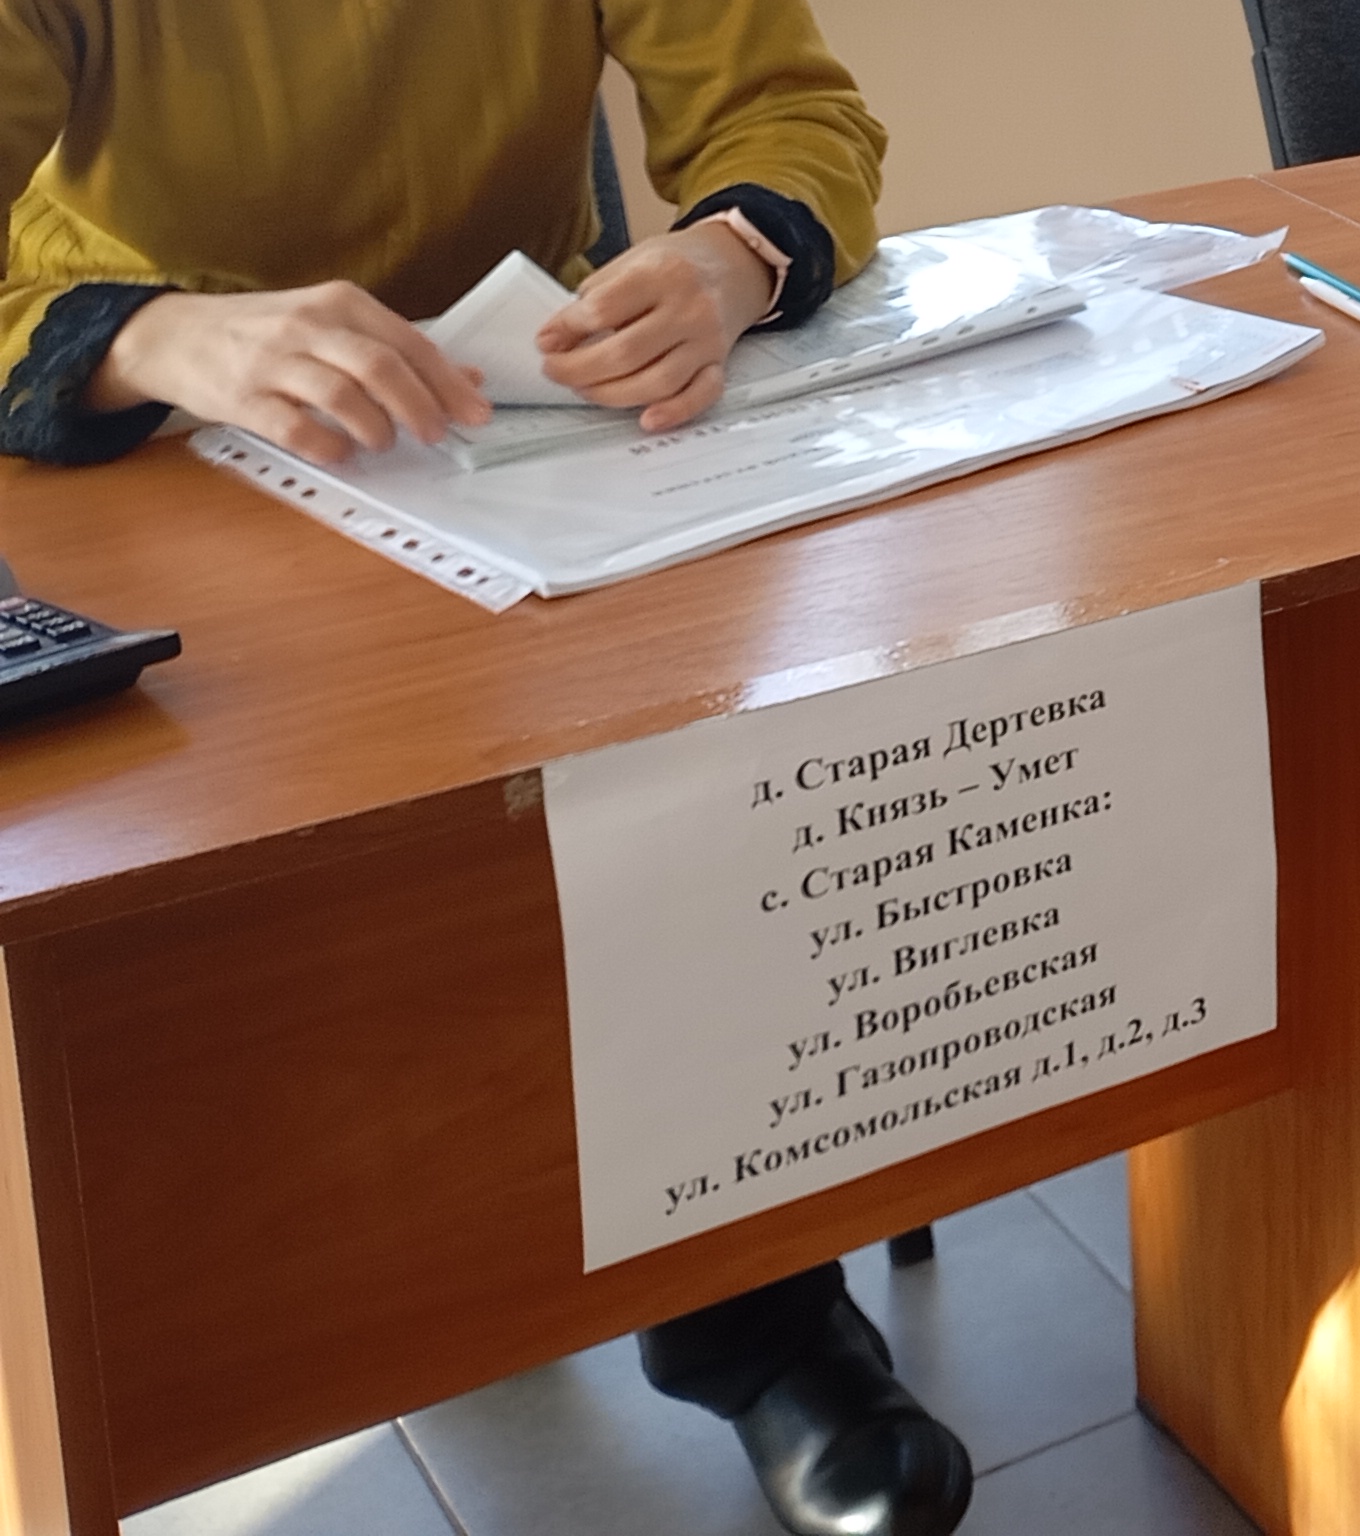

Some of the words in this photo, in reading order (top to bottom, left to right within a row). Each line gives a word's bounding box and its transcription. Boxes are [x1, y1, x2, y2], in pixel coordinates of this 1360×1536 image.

[750, 778, 785, 810] д.
[793, 735, 932, 792] Старая
[941, 688, 1108, 760] Дертевка
[791, 824, 825, 854] д.
[836, 787, 950, 838] Князь
[987, 747, 1080, 792] Умет
[759, 889, 790, 914] с.
[799, 841, 935, 900] Старая
[947, 790, 1113, 858] Каменка:
[809, 919, 864, 961] ул.
[875, 852, 1073, 932] Быстровка
[787, 1030, 843, 1073] ул.
[854, 942, 1099, 1042] Воробьевская
[827, 966, 881, 1008] ул.
[892, 906, 1061, 978] Виглевка
[664, 1174, 721, 1217] ул.
[734, 1065, 1022, 1184] Комсомольская
[1031, 1040, 1090, 1083] д.1,
[1096, 1017, 1155, 1061] д.2,
[1160, 995, 1208, 1038] д.3
[768, 1088, 824, 1130] ул.
[836, 984, 1118, 1099] Газопроводская
